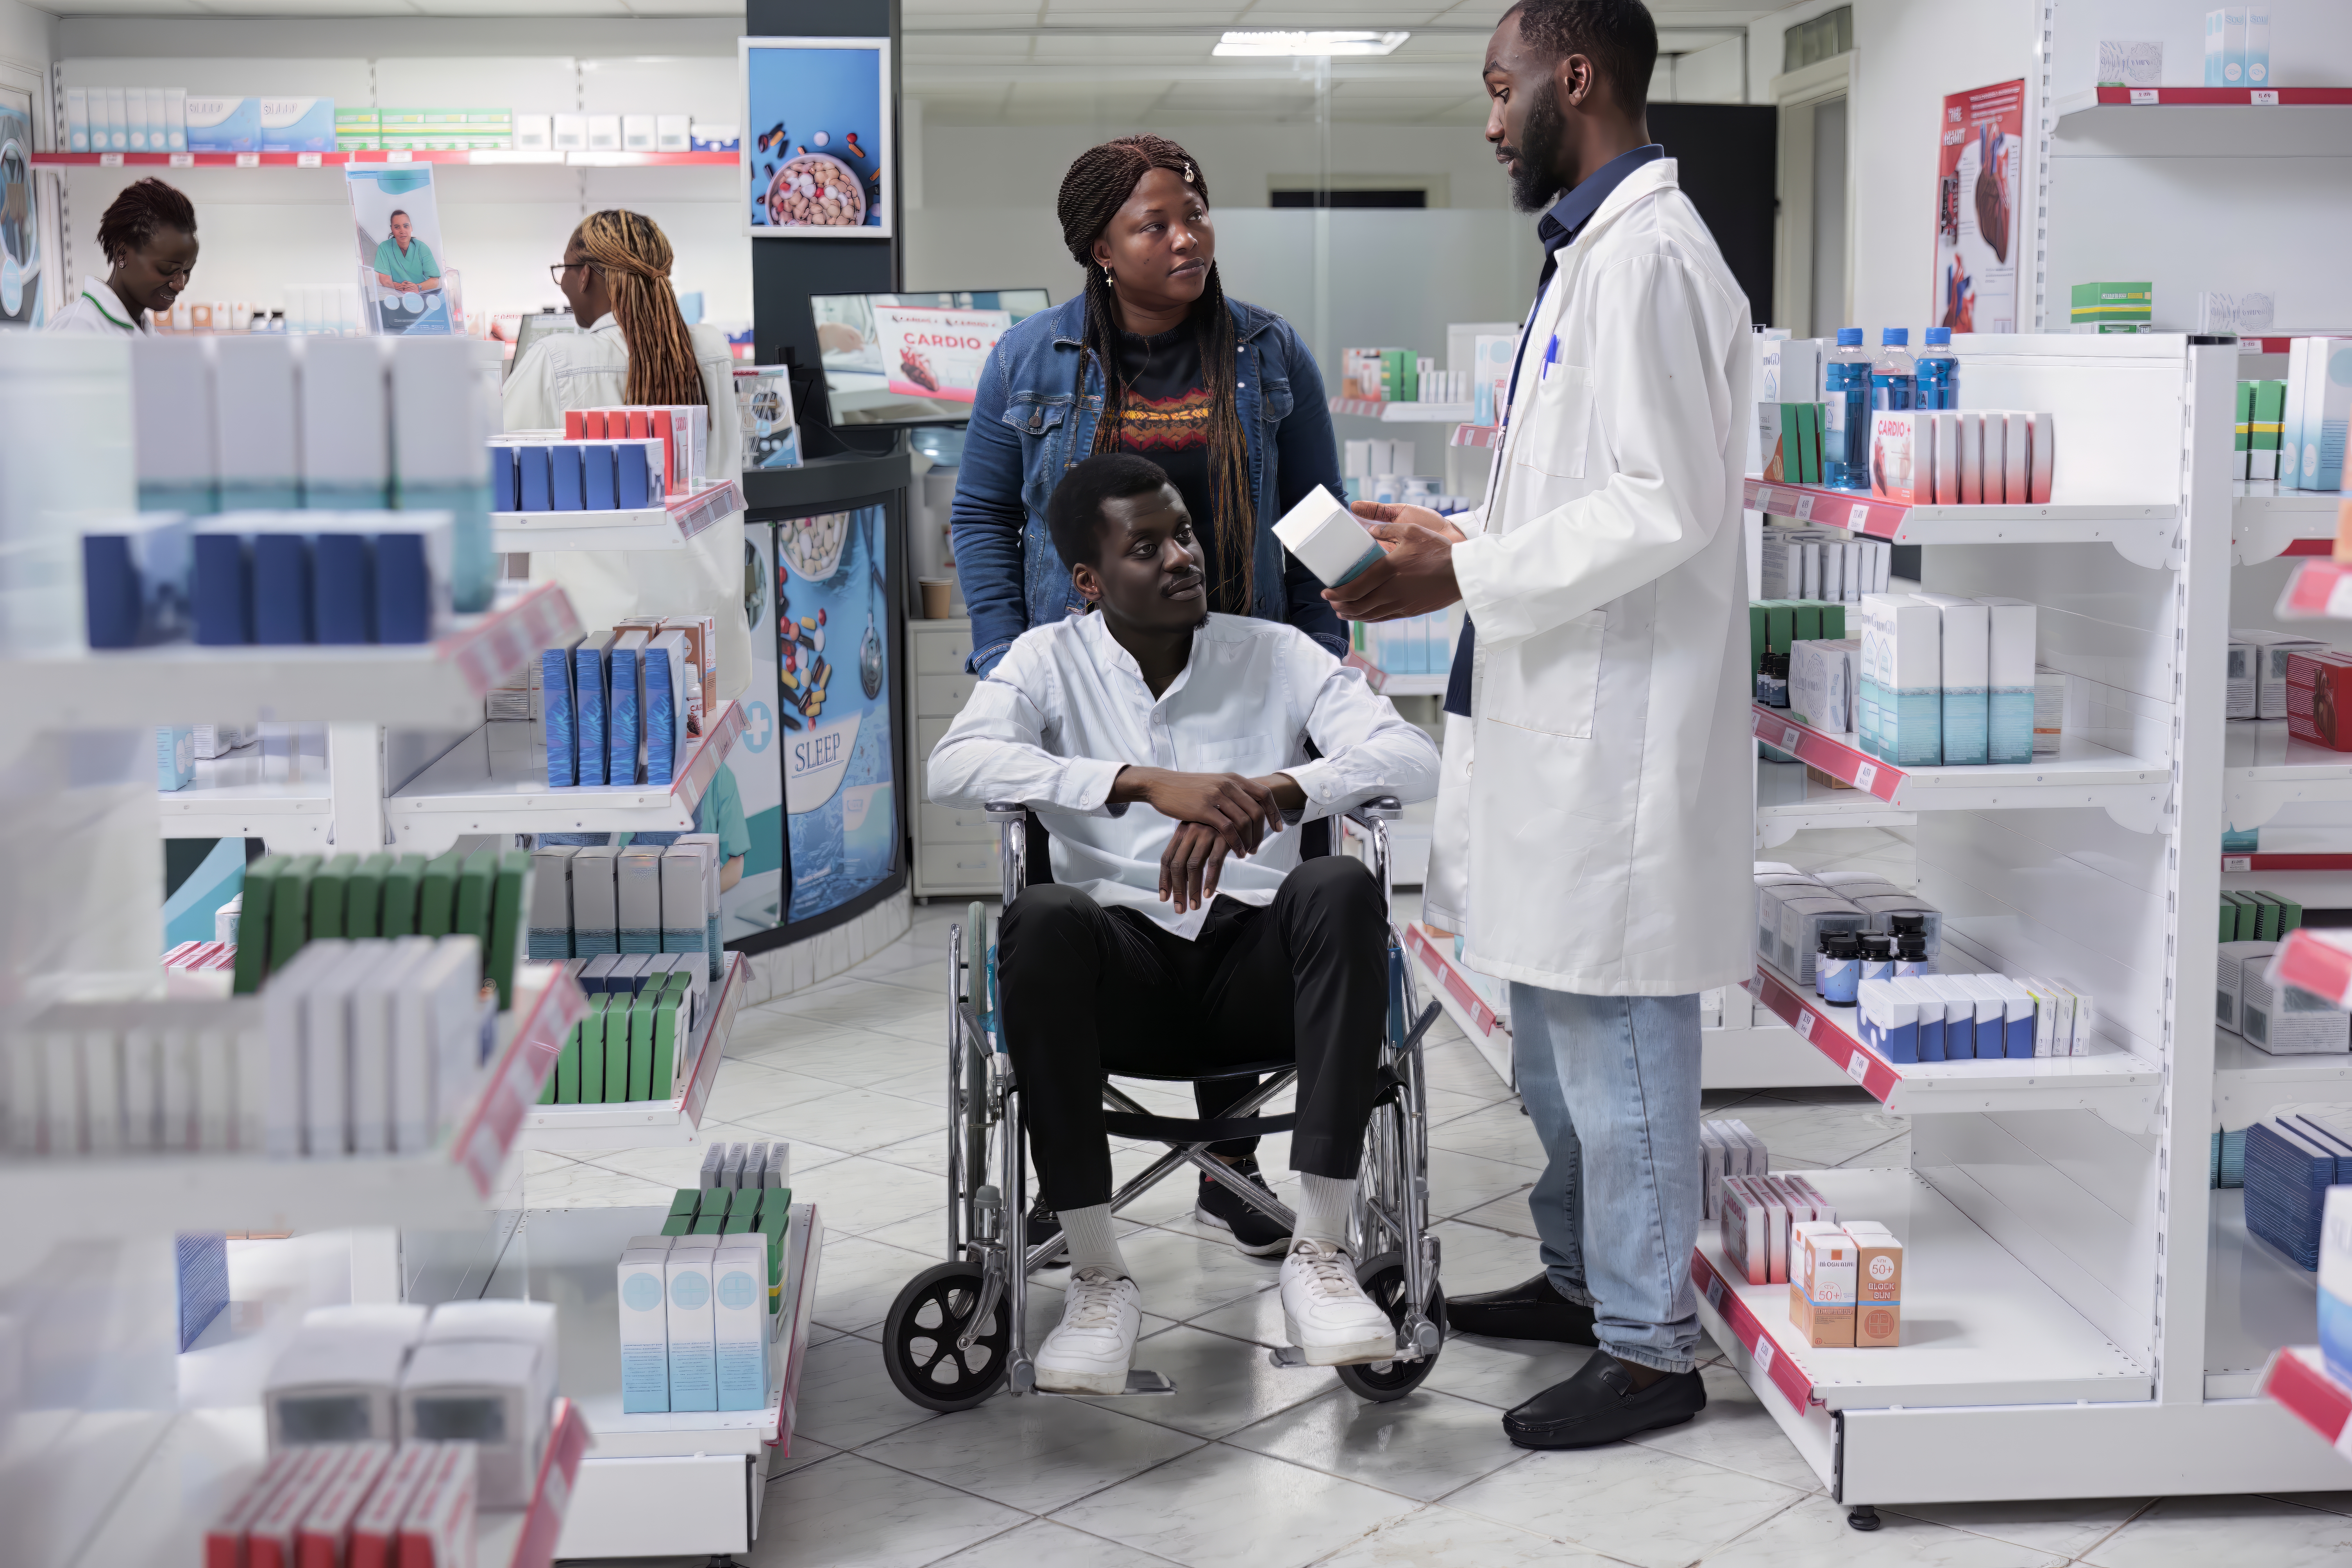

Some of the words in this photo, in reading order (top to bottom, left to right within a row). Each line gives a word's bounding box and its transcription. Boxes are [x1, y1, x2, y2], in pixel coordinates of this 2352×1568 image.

[903, 333, 981, 349] CARDIO
[1878, 420, 1905, 437] CARDIO
[795, 732, 840, 772] SLEEP
